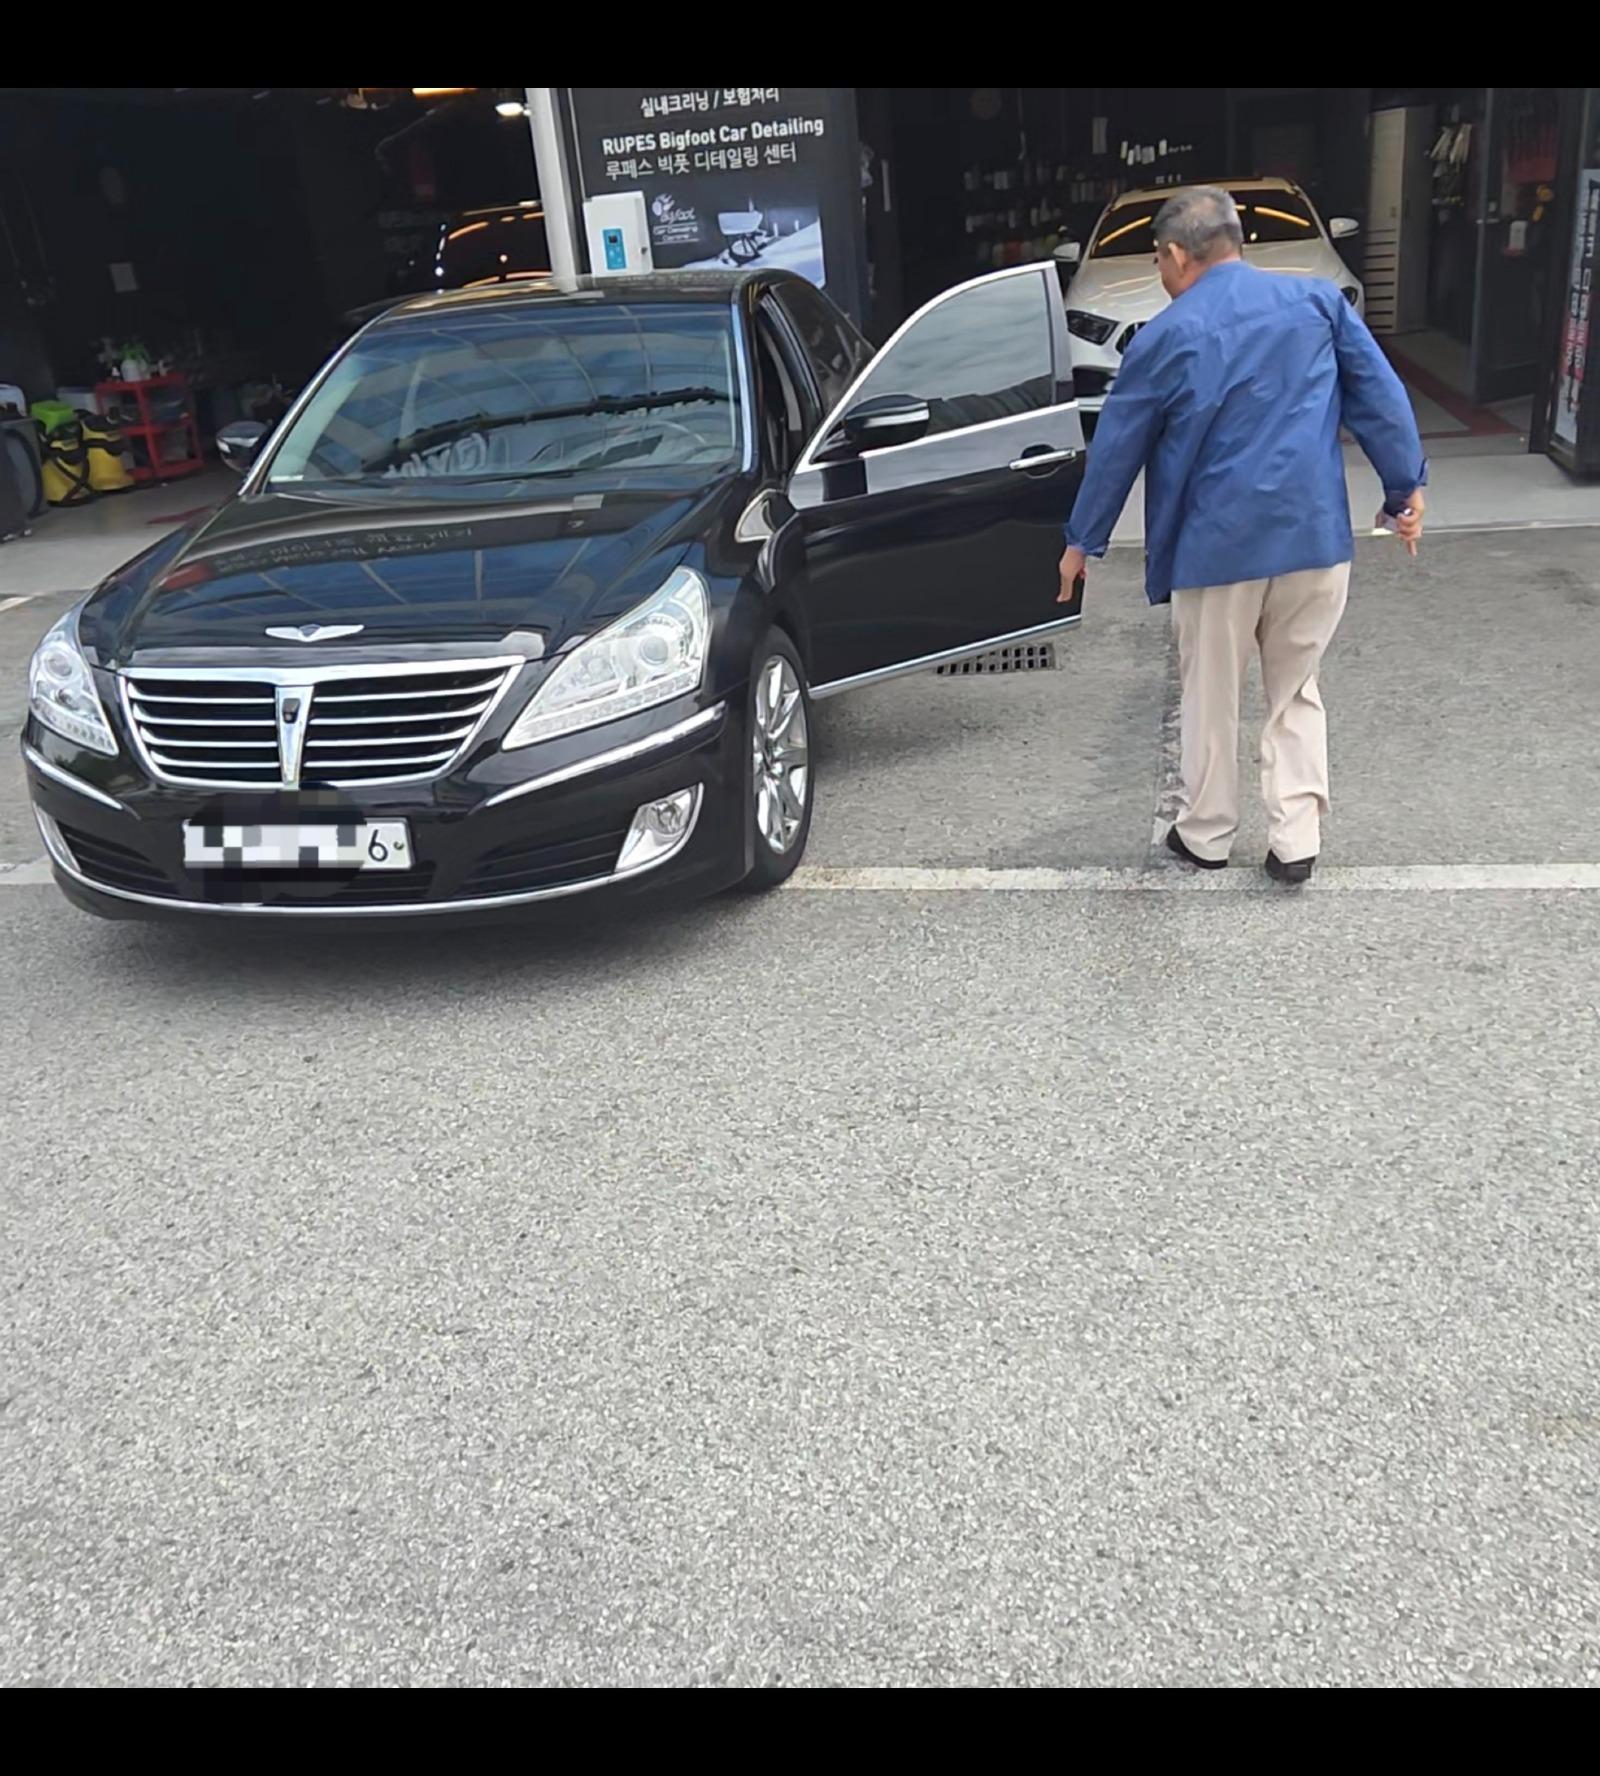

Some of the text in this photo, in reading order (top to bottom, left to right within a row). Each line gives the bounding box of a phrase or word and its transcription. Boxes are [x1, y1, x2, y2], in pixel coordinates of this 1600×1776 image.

[640, 90, 710, 118] 실내크리닝
[602, 116, 824, 155] RUPES Bigfoot Car Detailing
[605, 141, 797, 181] 루페스 빅풋 디테일링 센터
